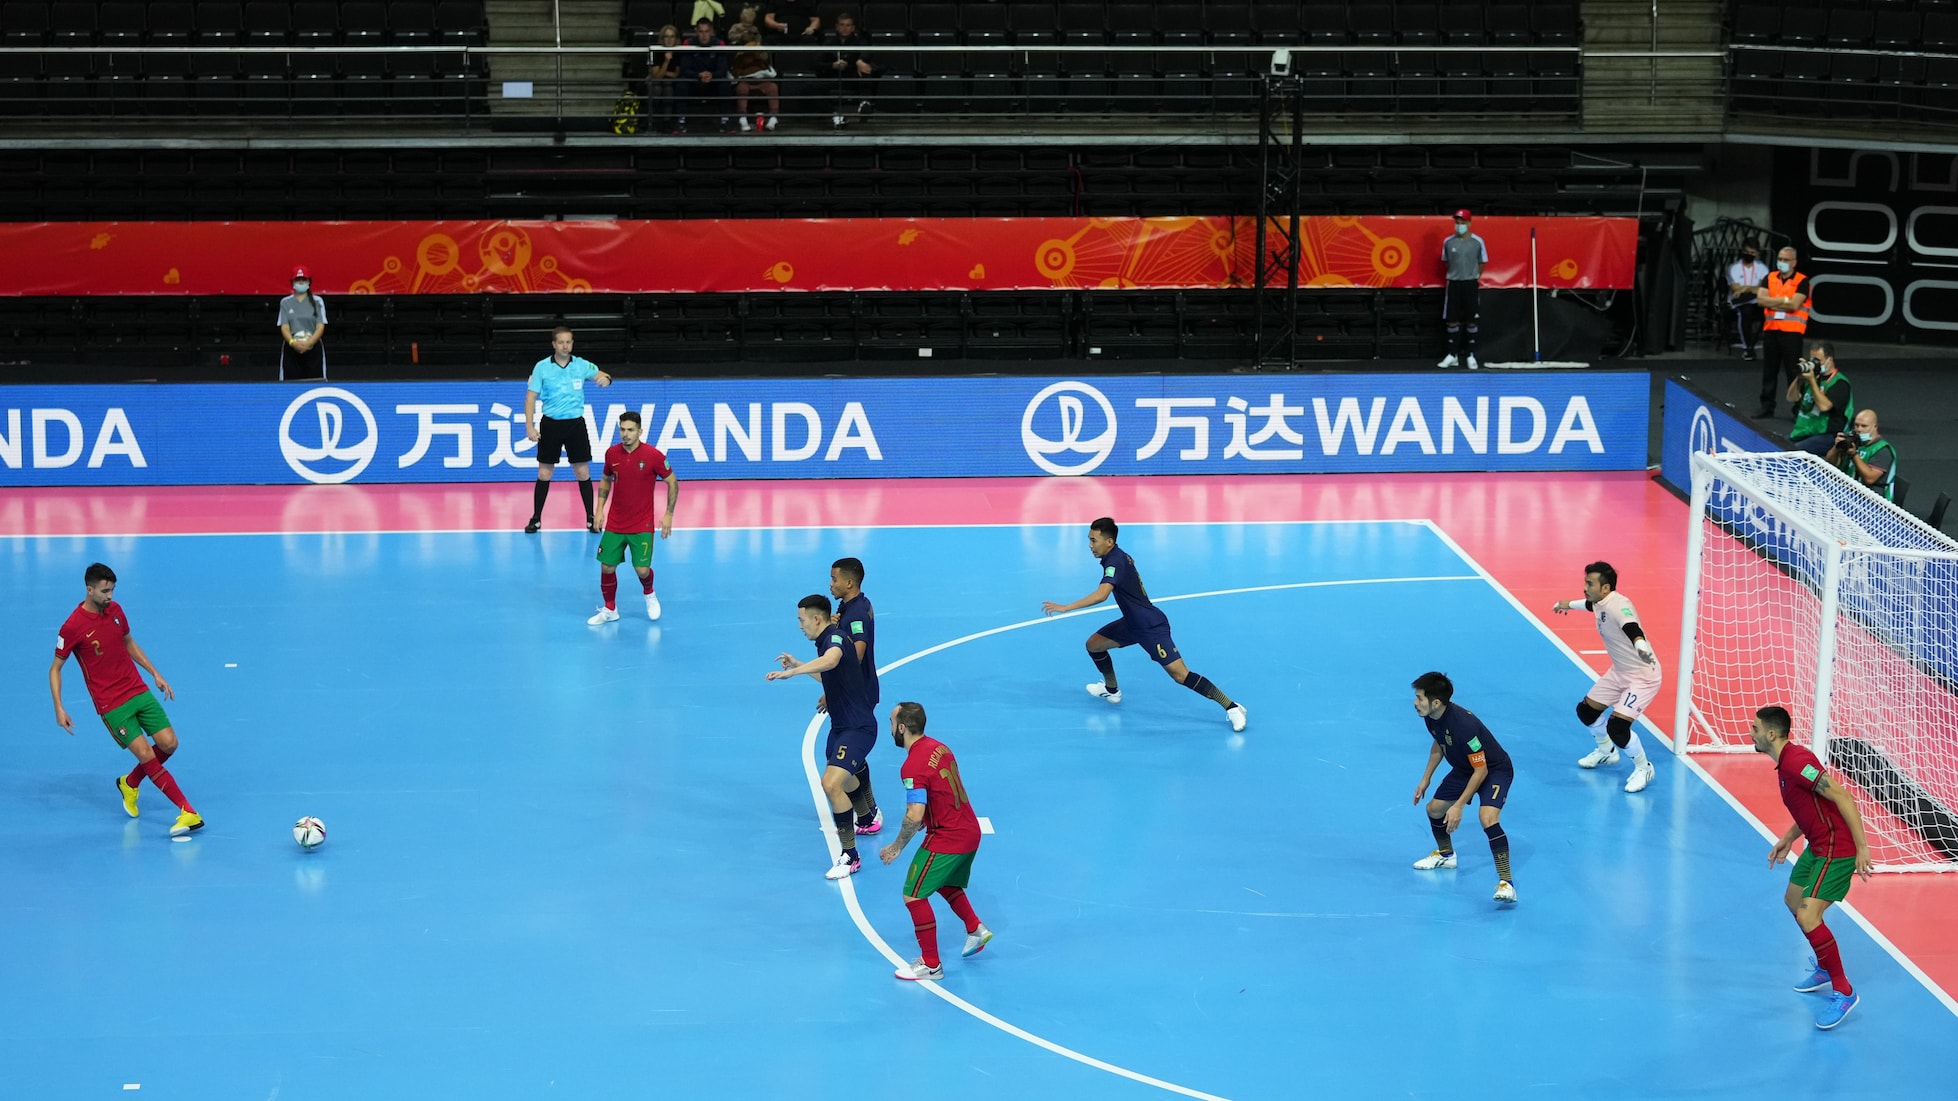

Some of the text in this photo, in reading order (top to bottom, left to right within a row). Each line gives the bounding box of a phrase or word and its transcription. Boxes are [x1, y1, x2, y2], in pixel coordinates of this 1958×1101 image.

[582, 402, 884, 463] WANDA
[1135, 394, 1605, 461] 万达 WANDA
[641, 542, 649, 557] 7
[91, 639, 104, 656] 2
[1156, 643, 1168, 659] 6
[1623, 691, 1638, 709] 12
[836, 745, 848, 760] 5
[1491, 784, 1501, 800] 7
